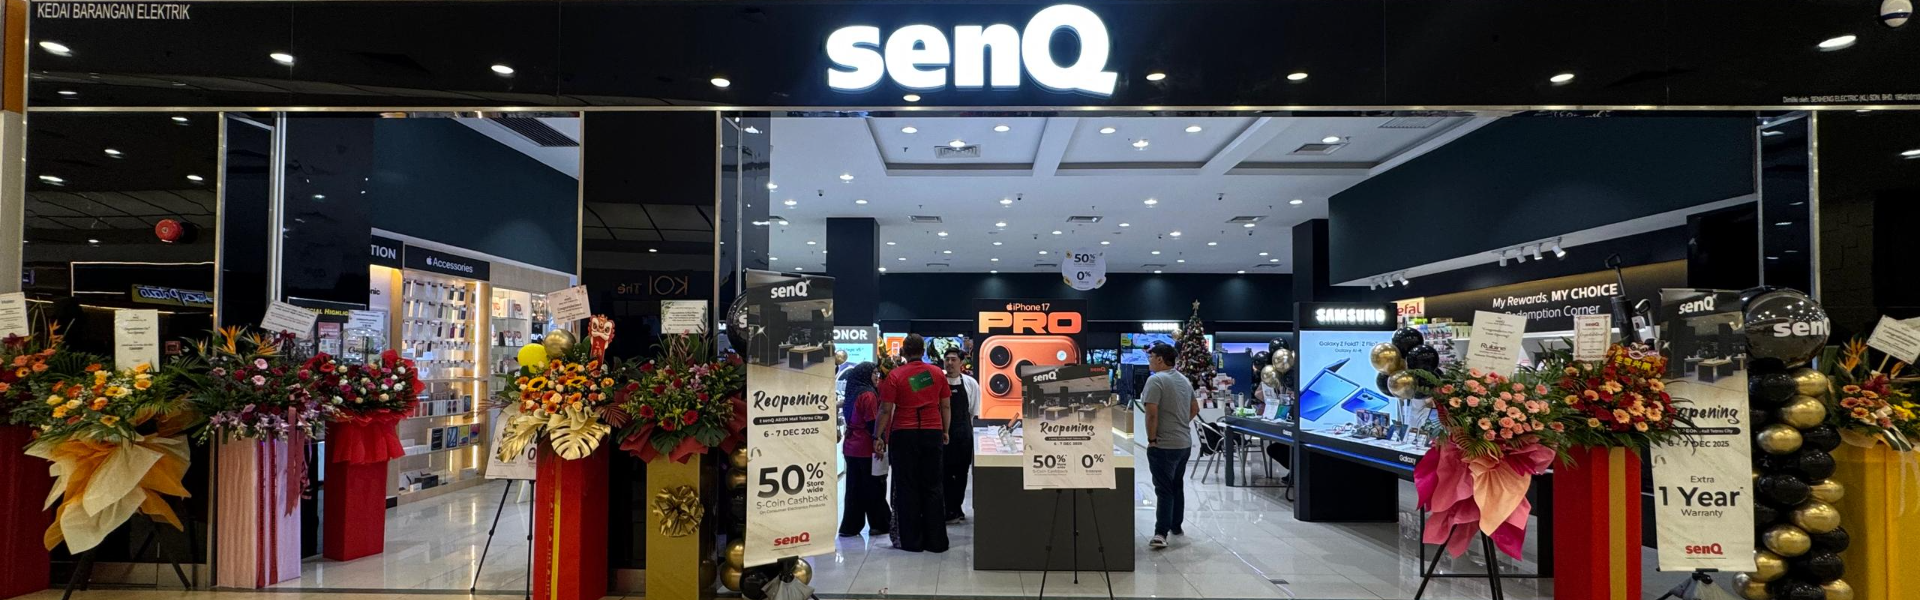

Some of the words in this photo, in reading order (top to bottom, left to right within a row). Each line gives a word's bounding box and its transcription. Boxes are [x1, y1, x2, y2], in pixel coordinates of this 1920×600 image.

[37, 3, 70, 18] KEDAI
[73, 3, 134, 19] BARANGAN
[137, 4, 190, 20] ELEKTRIK
[826, 4, 1118, 96] senQ
[433, 257, 473, 273] Accessories
[770, 281, 808, 299] senQ
[1492, 298, 1505, 309] My
[1507, 292, 1549, 306] Rewards,
[1551, 289, 1569, 302] MY
[1570, 283, 1618, 299] CHOICE
[1013, 302, 1041, 311] iPhone
[1041, 303, 1050, 311] 17
[1397, 302, 1421, 316] efal
[1563, 305, 1600, 317] Corner
[1678, 296, 1714, 314] senQ
[1316, 308, 1385, 321] SAMSUNG
[978, 311, 1081, 334] PRO
[833, 329, 868, 340] ONOR
[1033, 371, 1057, 382] senQ
[753, 390, 829, 412] Reopening
[783, 428, 799, 436] DEC
[801, 427, 819, 435] 2025
[1040, 421, 1095, 436] Reopening
[1399, 454, 1417, 465] Galaxy
[1690, 475, 1715, 483] Extra
[756, 499, 785, 510] S-Coin
[787, 494, 828, 506] Cashback
[1659, 486, 1668, 506] 1
[1681, 509, 1723, 518] Warranty
[774, 532, 810, 546] senQ
[1685, 543, 1723, 555] senQ
